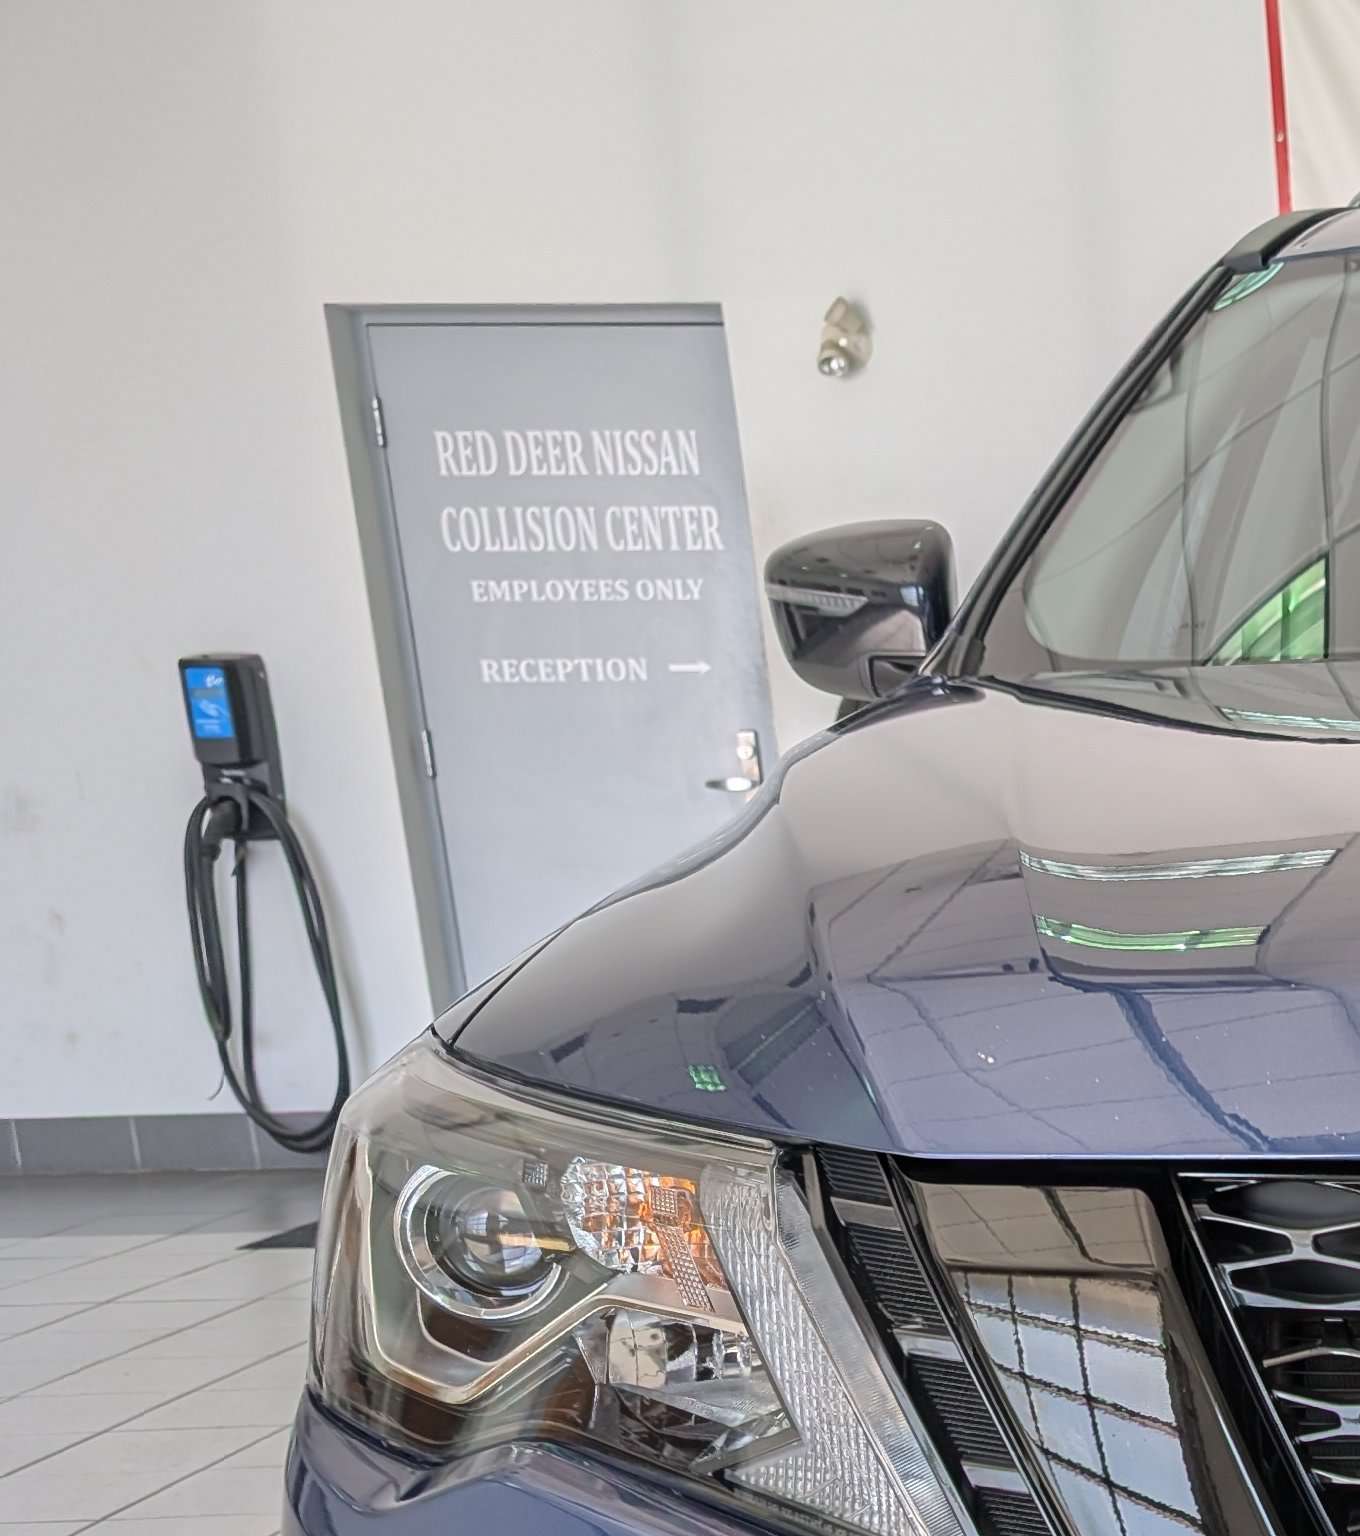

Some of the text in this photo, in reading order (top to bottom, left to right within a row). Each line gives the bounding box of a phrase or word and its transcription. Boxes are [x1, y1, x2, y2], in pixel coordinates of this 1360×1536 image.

[434, 429, 701, 477] RED DEER NISSAN
[440, 504, 724, 552] COLLISION CENTER
[471, 578, 704, 602] EMPLOYEES ONLY
[480, 658, 648, 683] RECEPTION
